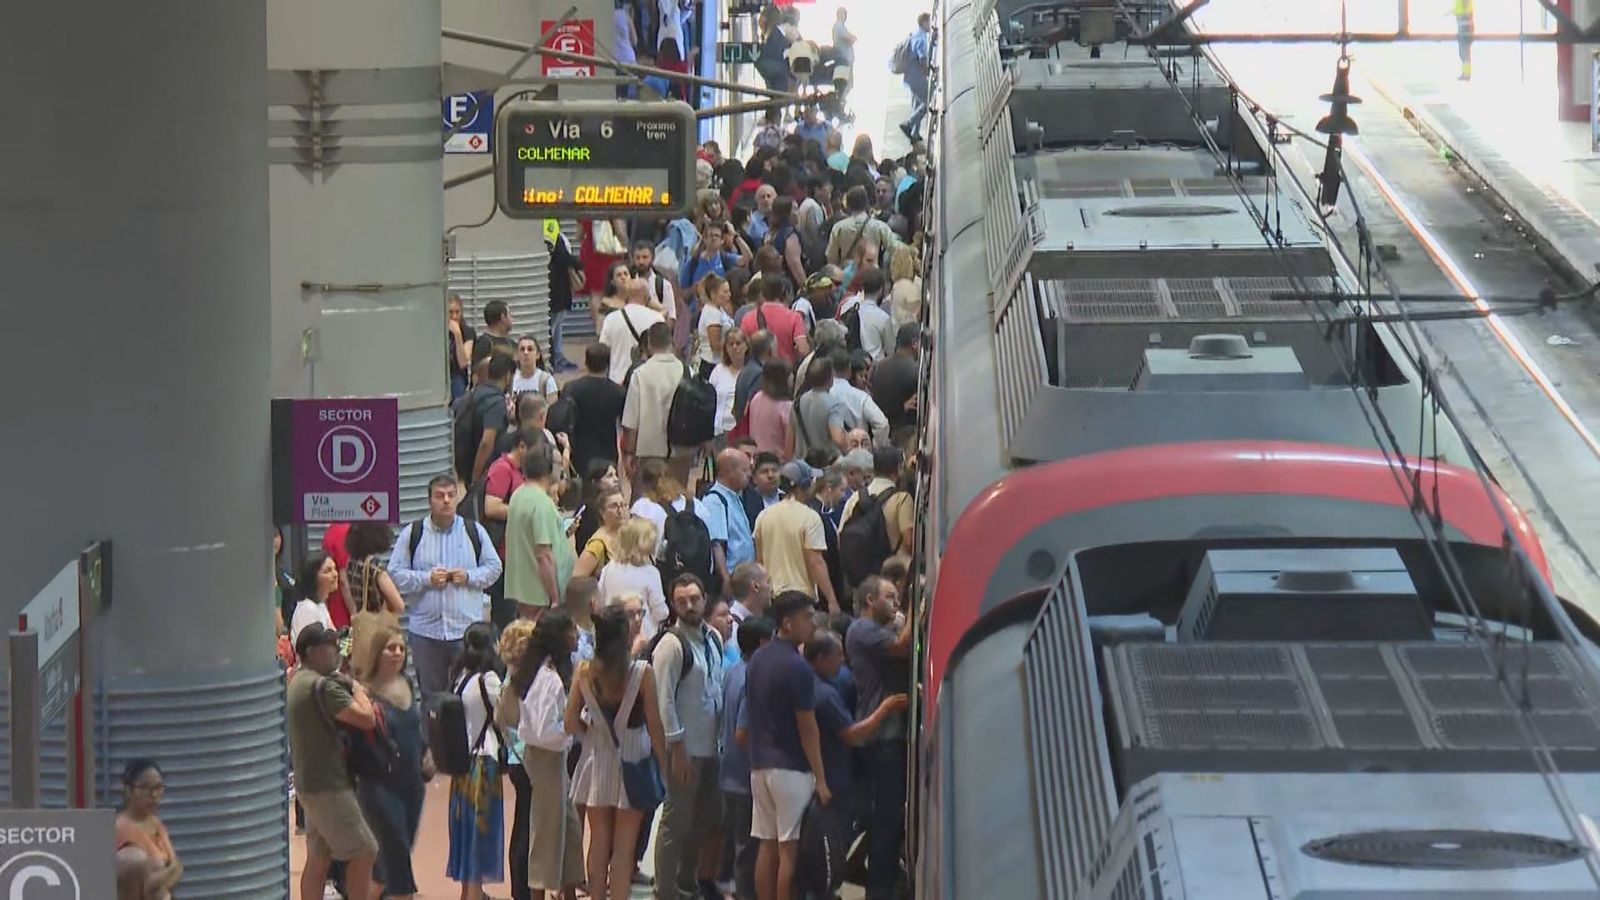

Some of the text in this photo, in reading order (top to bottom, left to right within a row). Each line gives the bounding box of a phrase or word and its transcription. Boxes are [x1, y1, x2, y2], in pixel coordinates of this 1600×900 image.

[549, 119, 614, 138] Vía 6
[646, 131, 666, 139] tren
[517, 147, 591, 161] COLMENAR
[575, 185, 654, 204] COLMENAR
[319, 409, 372, 421] SECTOR
[332, 434, 365, 473] D
[365, 499, 376, 513] 6
[0, 826, 75, 844] SECTOR
